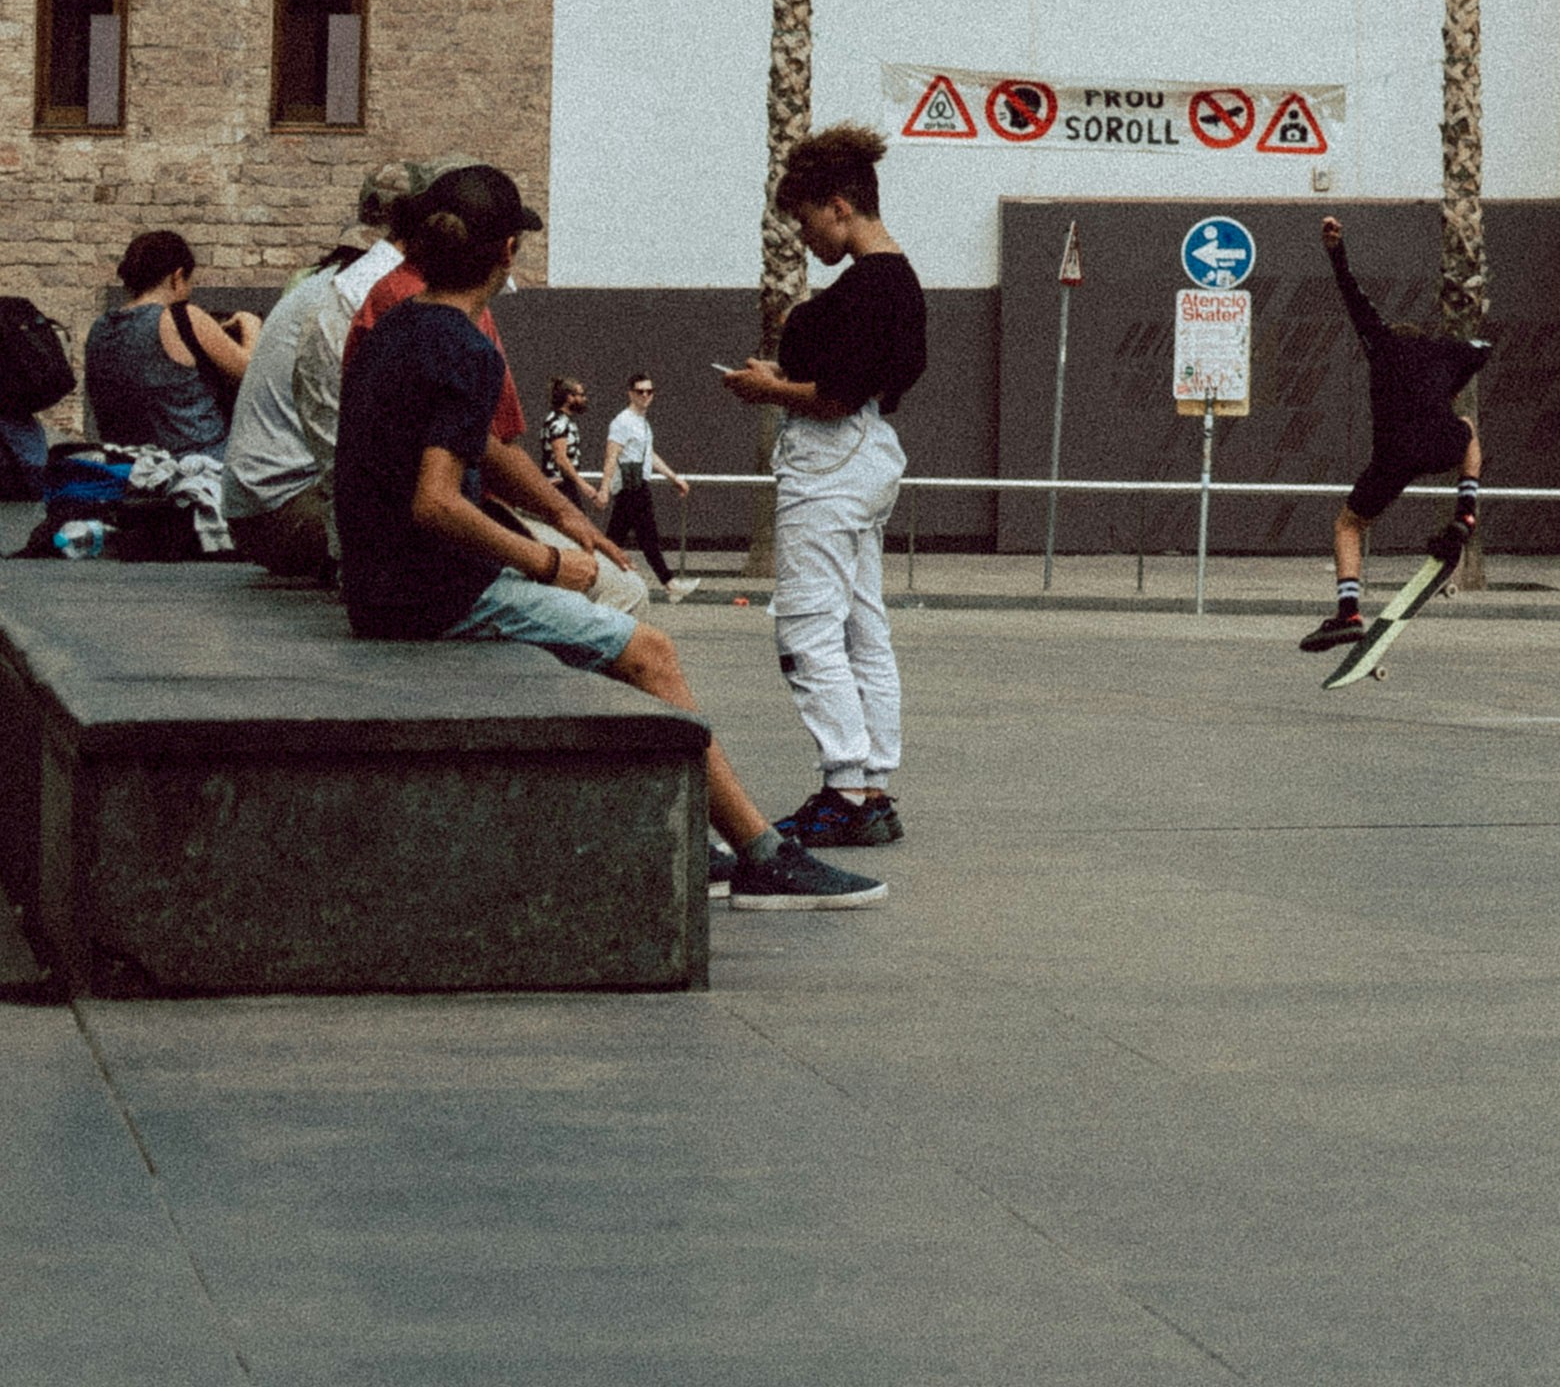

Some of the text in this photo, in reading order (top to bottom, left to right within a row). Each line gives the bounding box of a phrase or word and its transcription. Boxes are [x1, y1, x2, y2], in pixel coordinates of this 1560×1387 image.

[1083, 88, 1165, 110] PROU
[1065, 115, 1179, 145] SOROLL
[1181, 292, 1247, 309] Atenció
